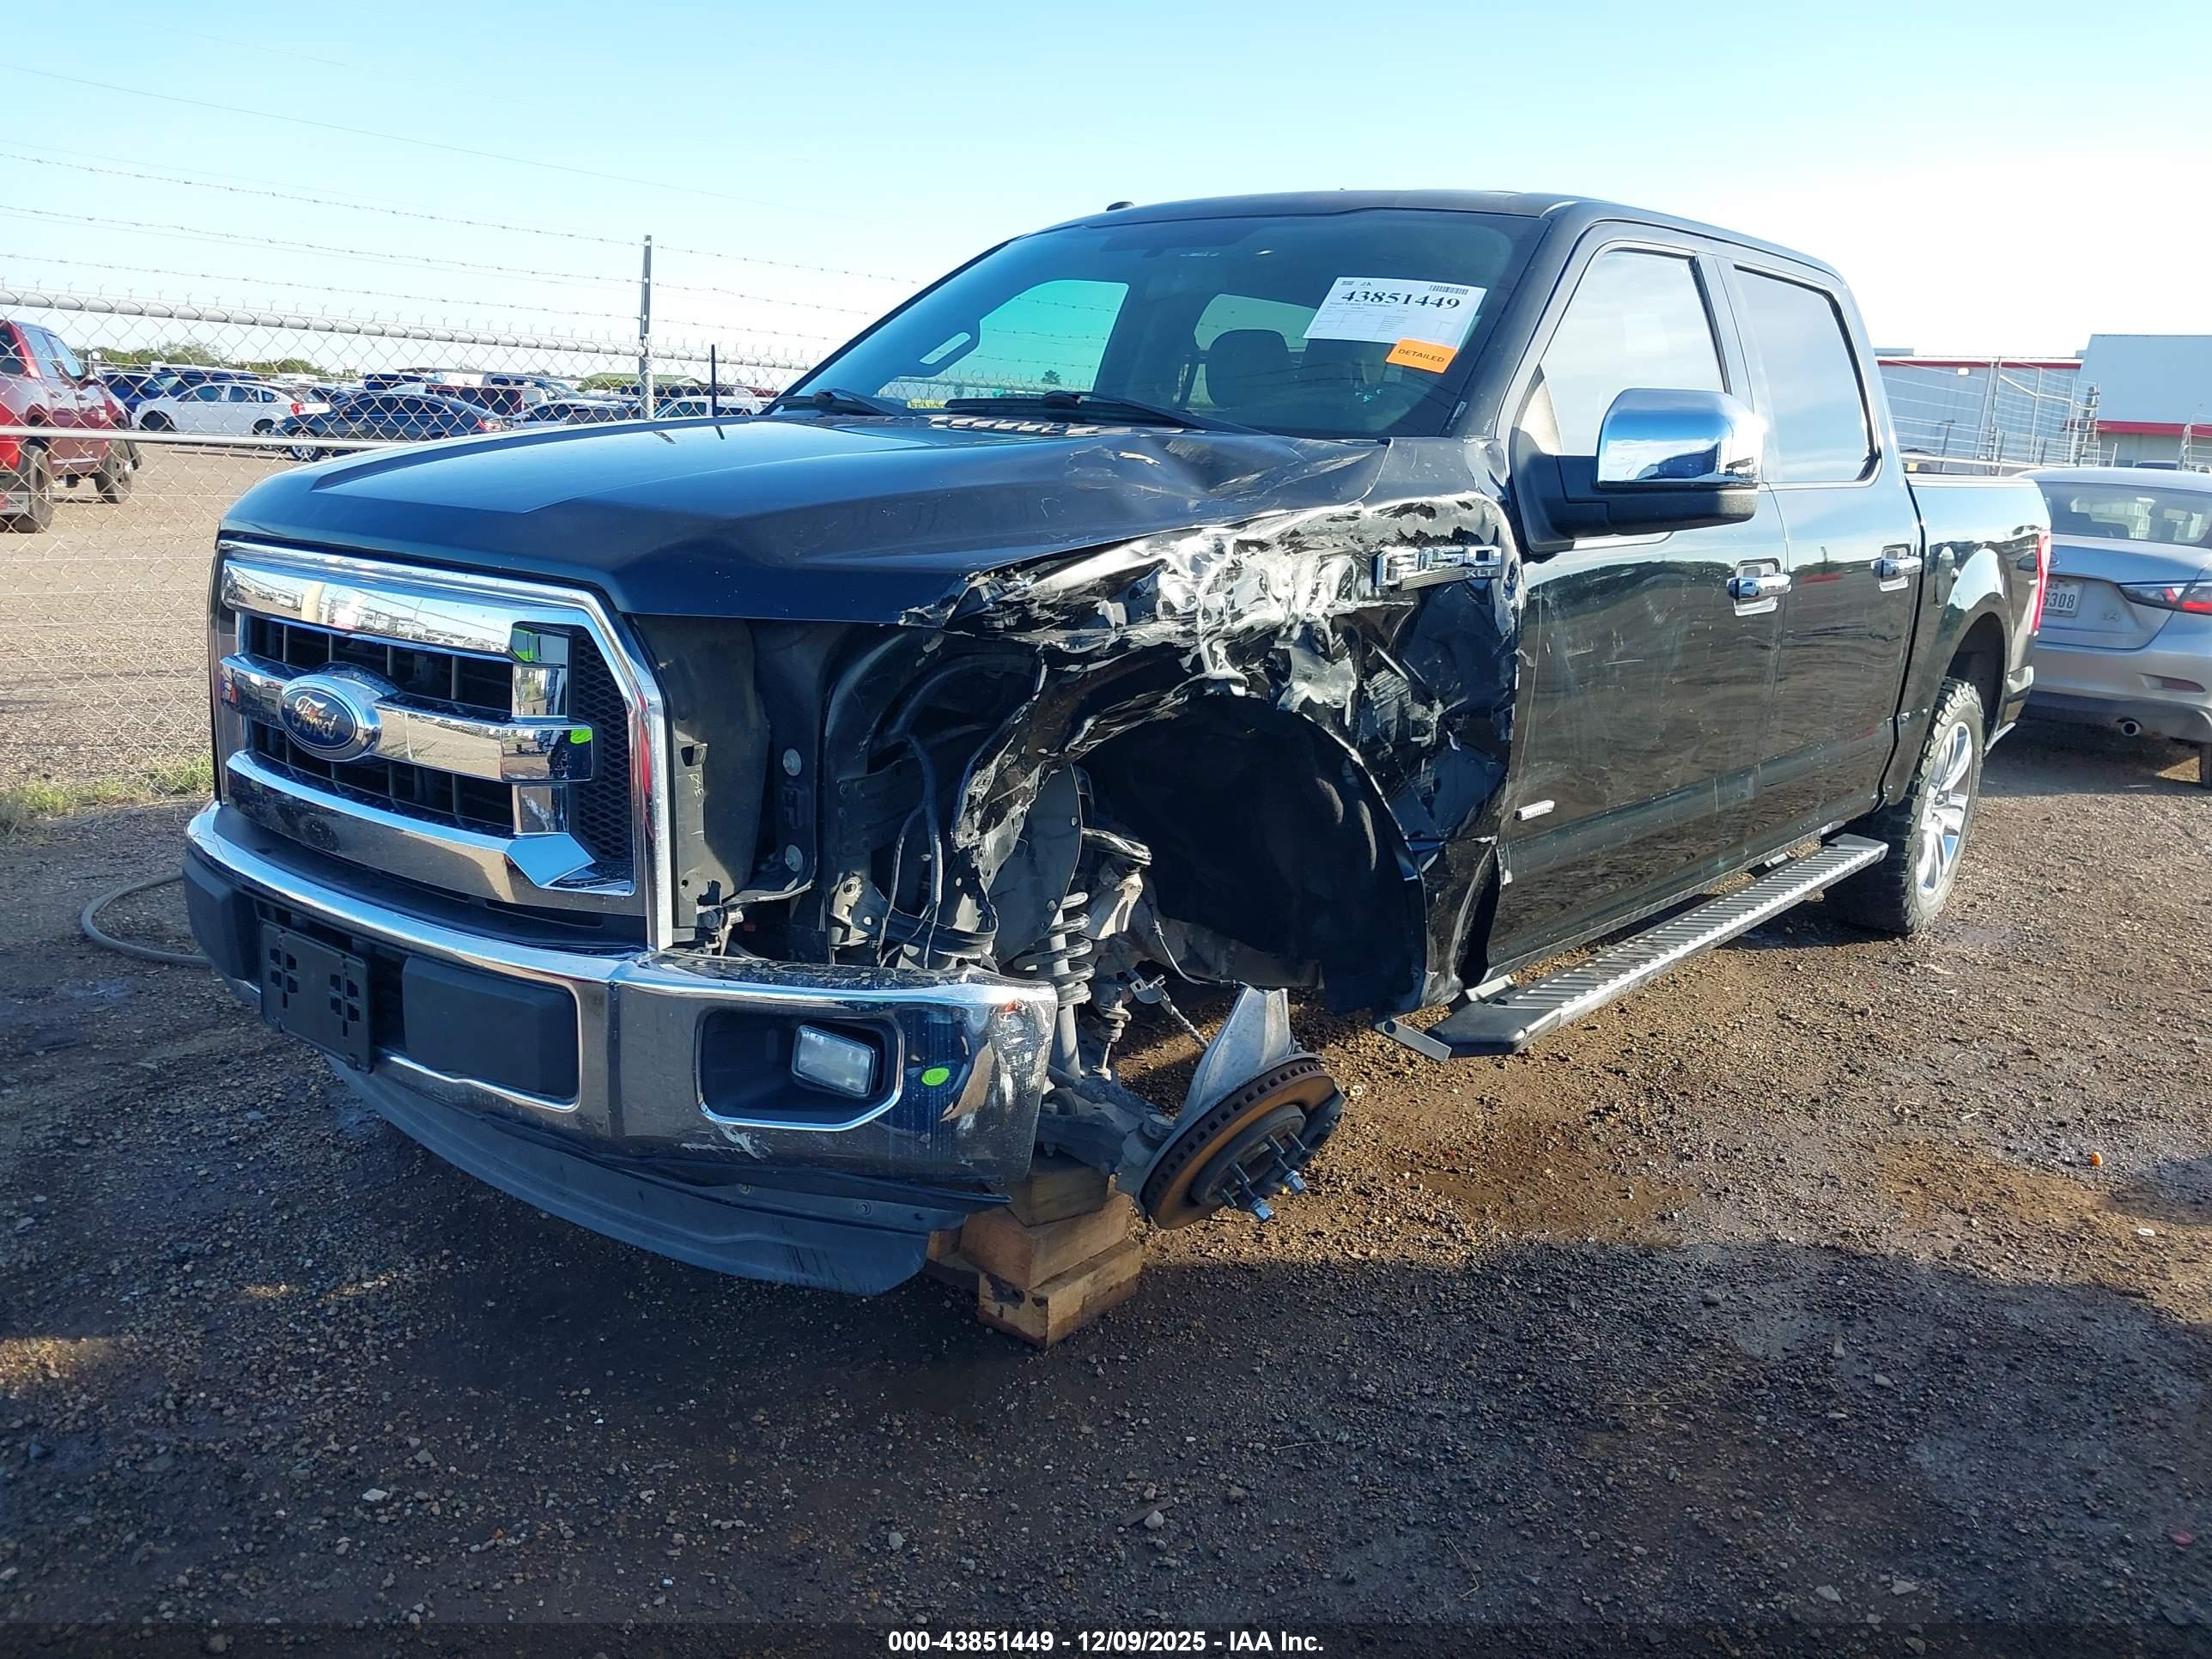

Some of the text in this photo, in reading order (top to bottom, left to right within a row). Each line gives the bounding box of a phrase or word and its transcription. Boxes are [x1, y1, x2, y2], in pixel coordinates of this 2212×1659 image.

[1341, 290, 1461, 310] 43851449
[1397, 348, 1445, 363] DETAILED
[1465, 568, 1497, 579] XLT
[290, 695, 338, 740] Ford
